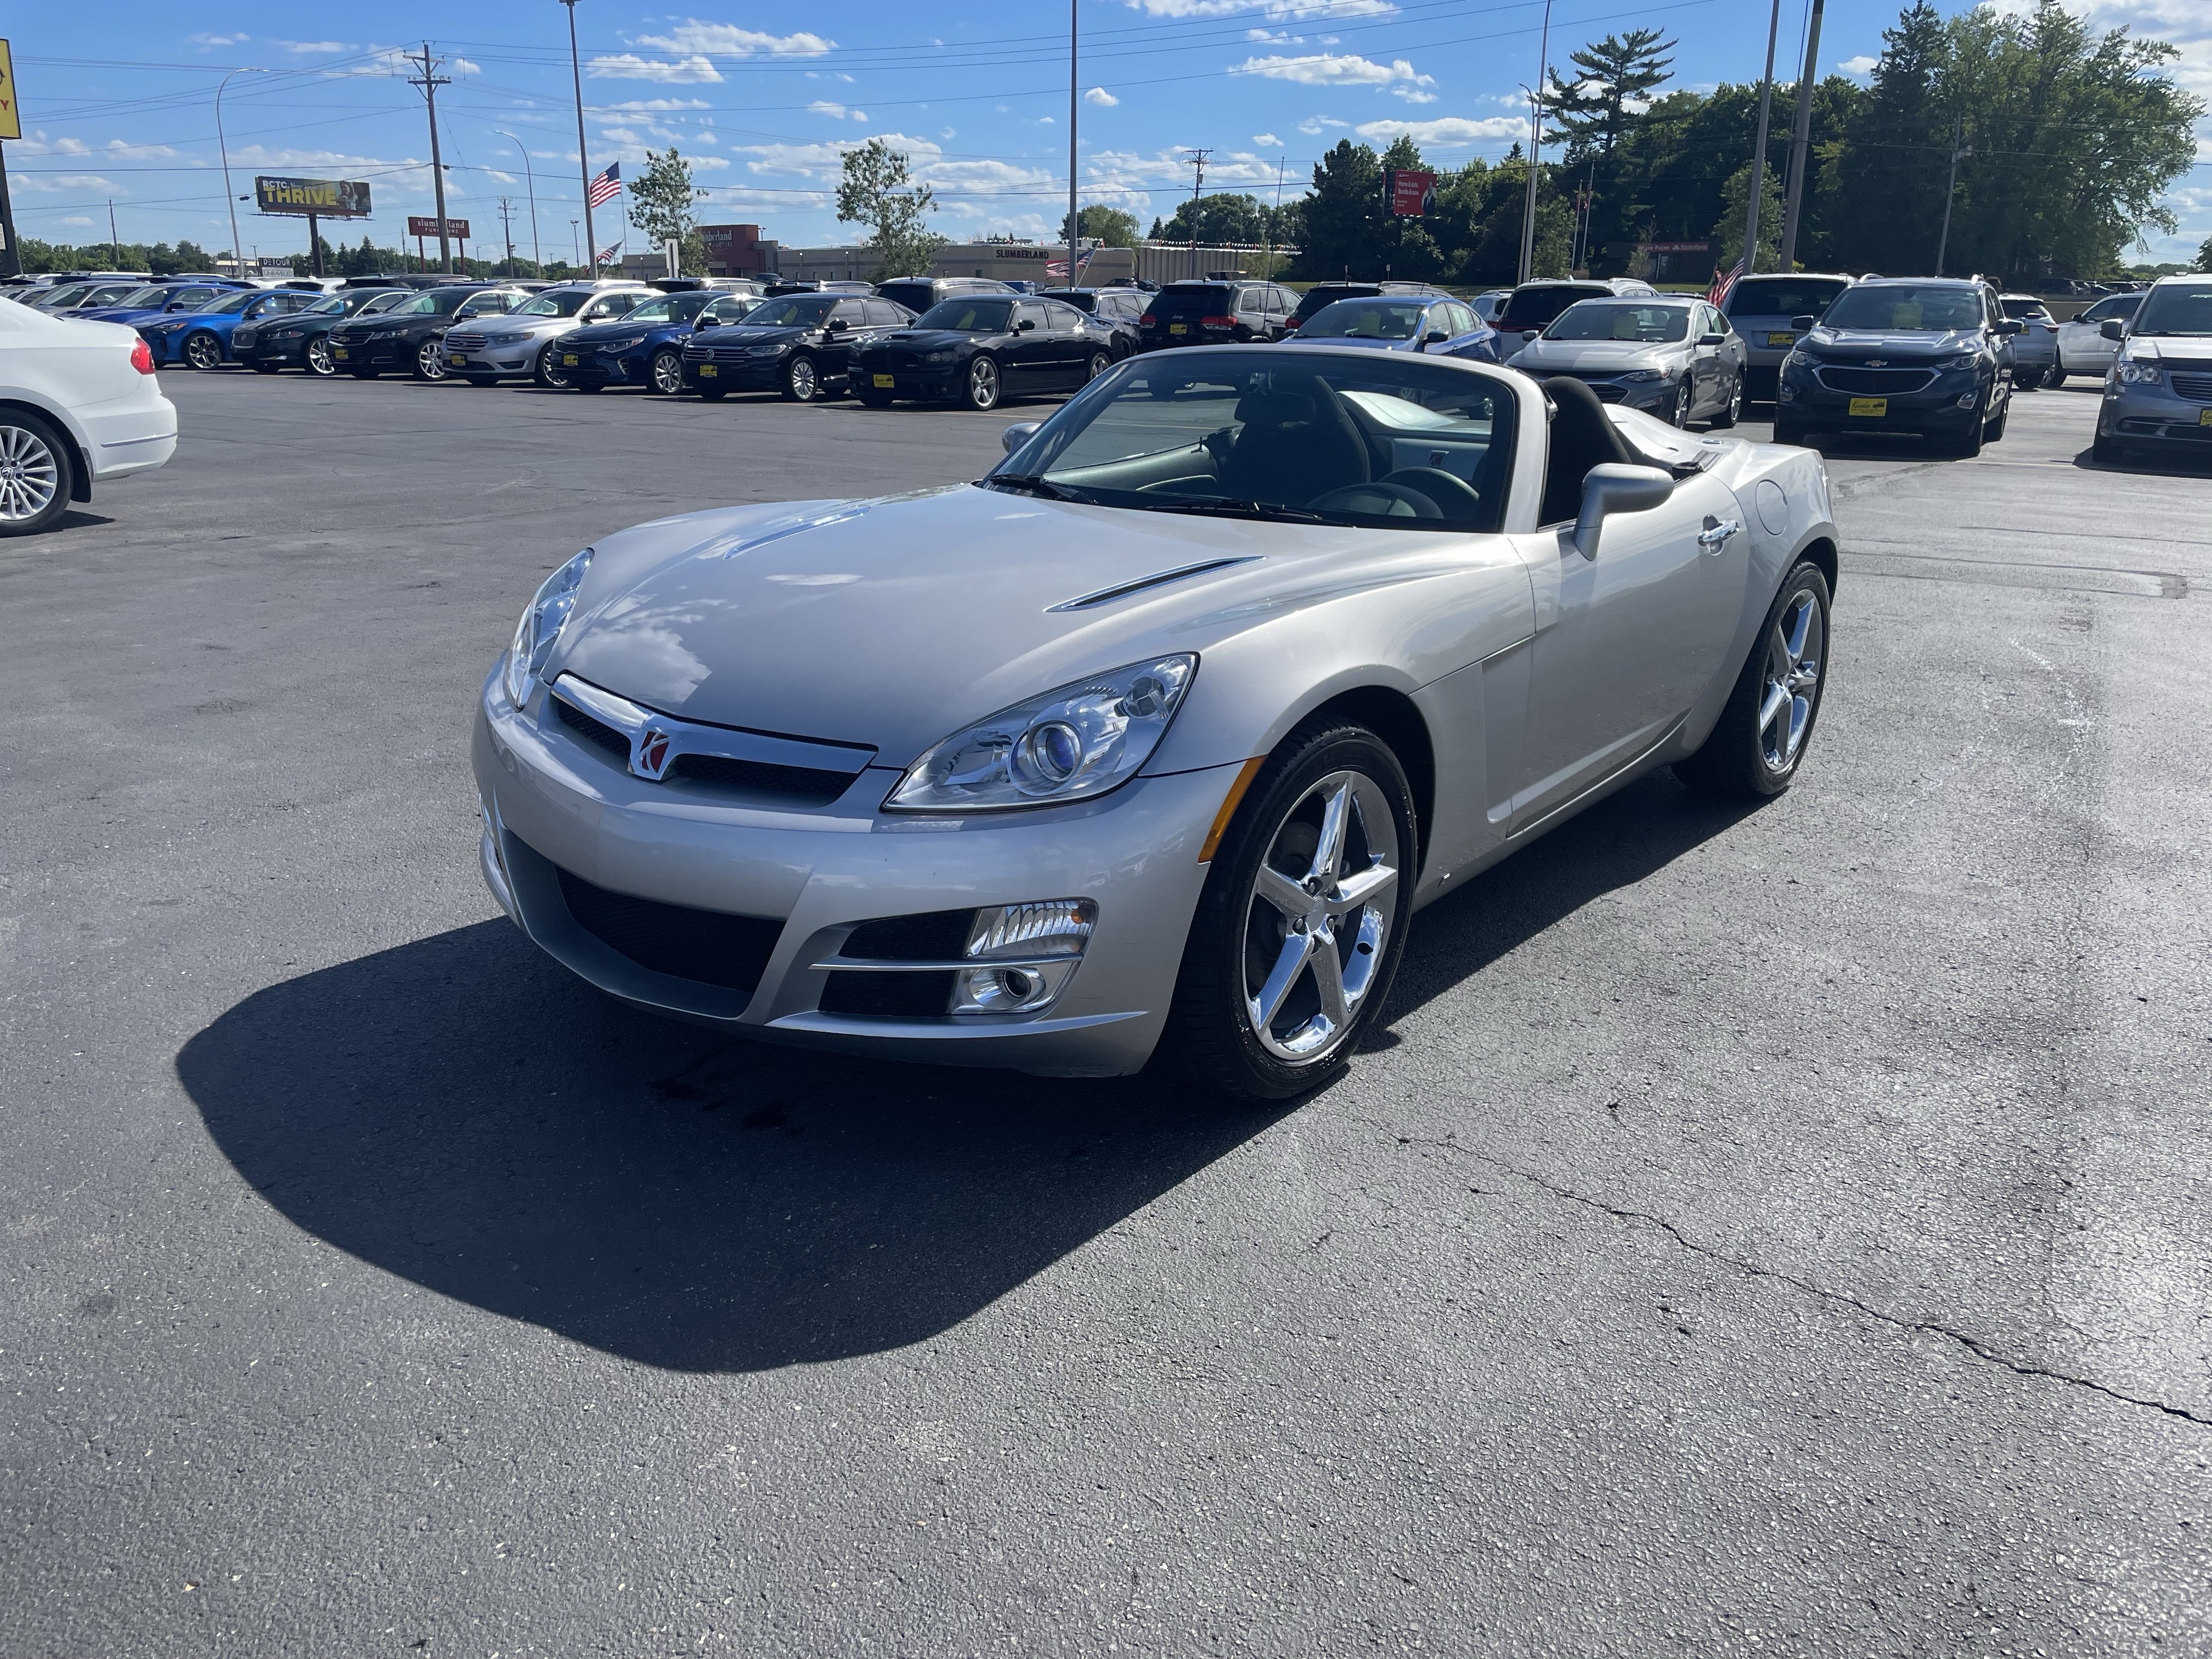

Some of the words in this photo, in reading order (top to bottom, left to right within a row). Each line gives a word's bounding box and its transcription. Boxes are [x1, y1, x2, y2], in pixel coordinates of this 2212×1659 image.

[262, 180, 290, 189] RCTC.
[263, 187, 340, 206] THRIVE.
[417, 218, 465, 229] slumland
[996, 250, 1049, 259] SLUMBERLAND
